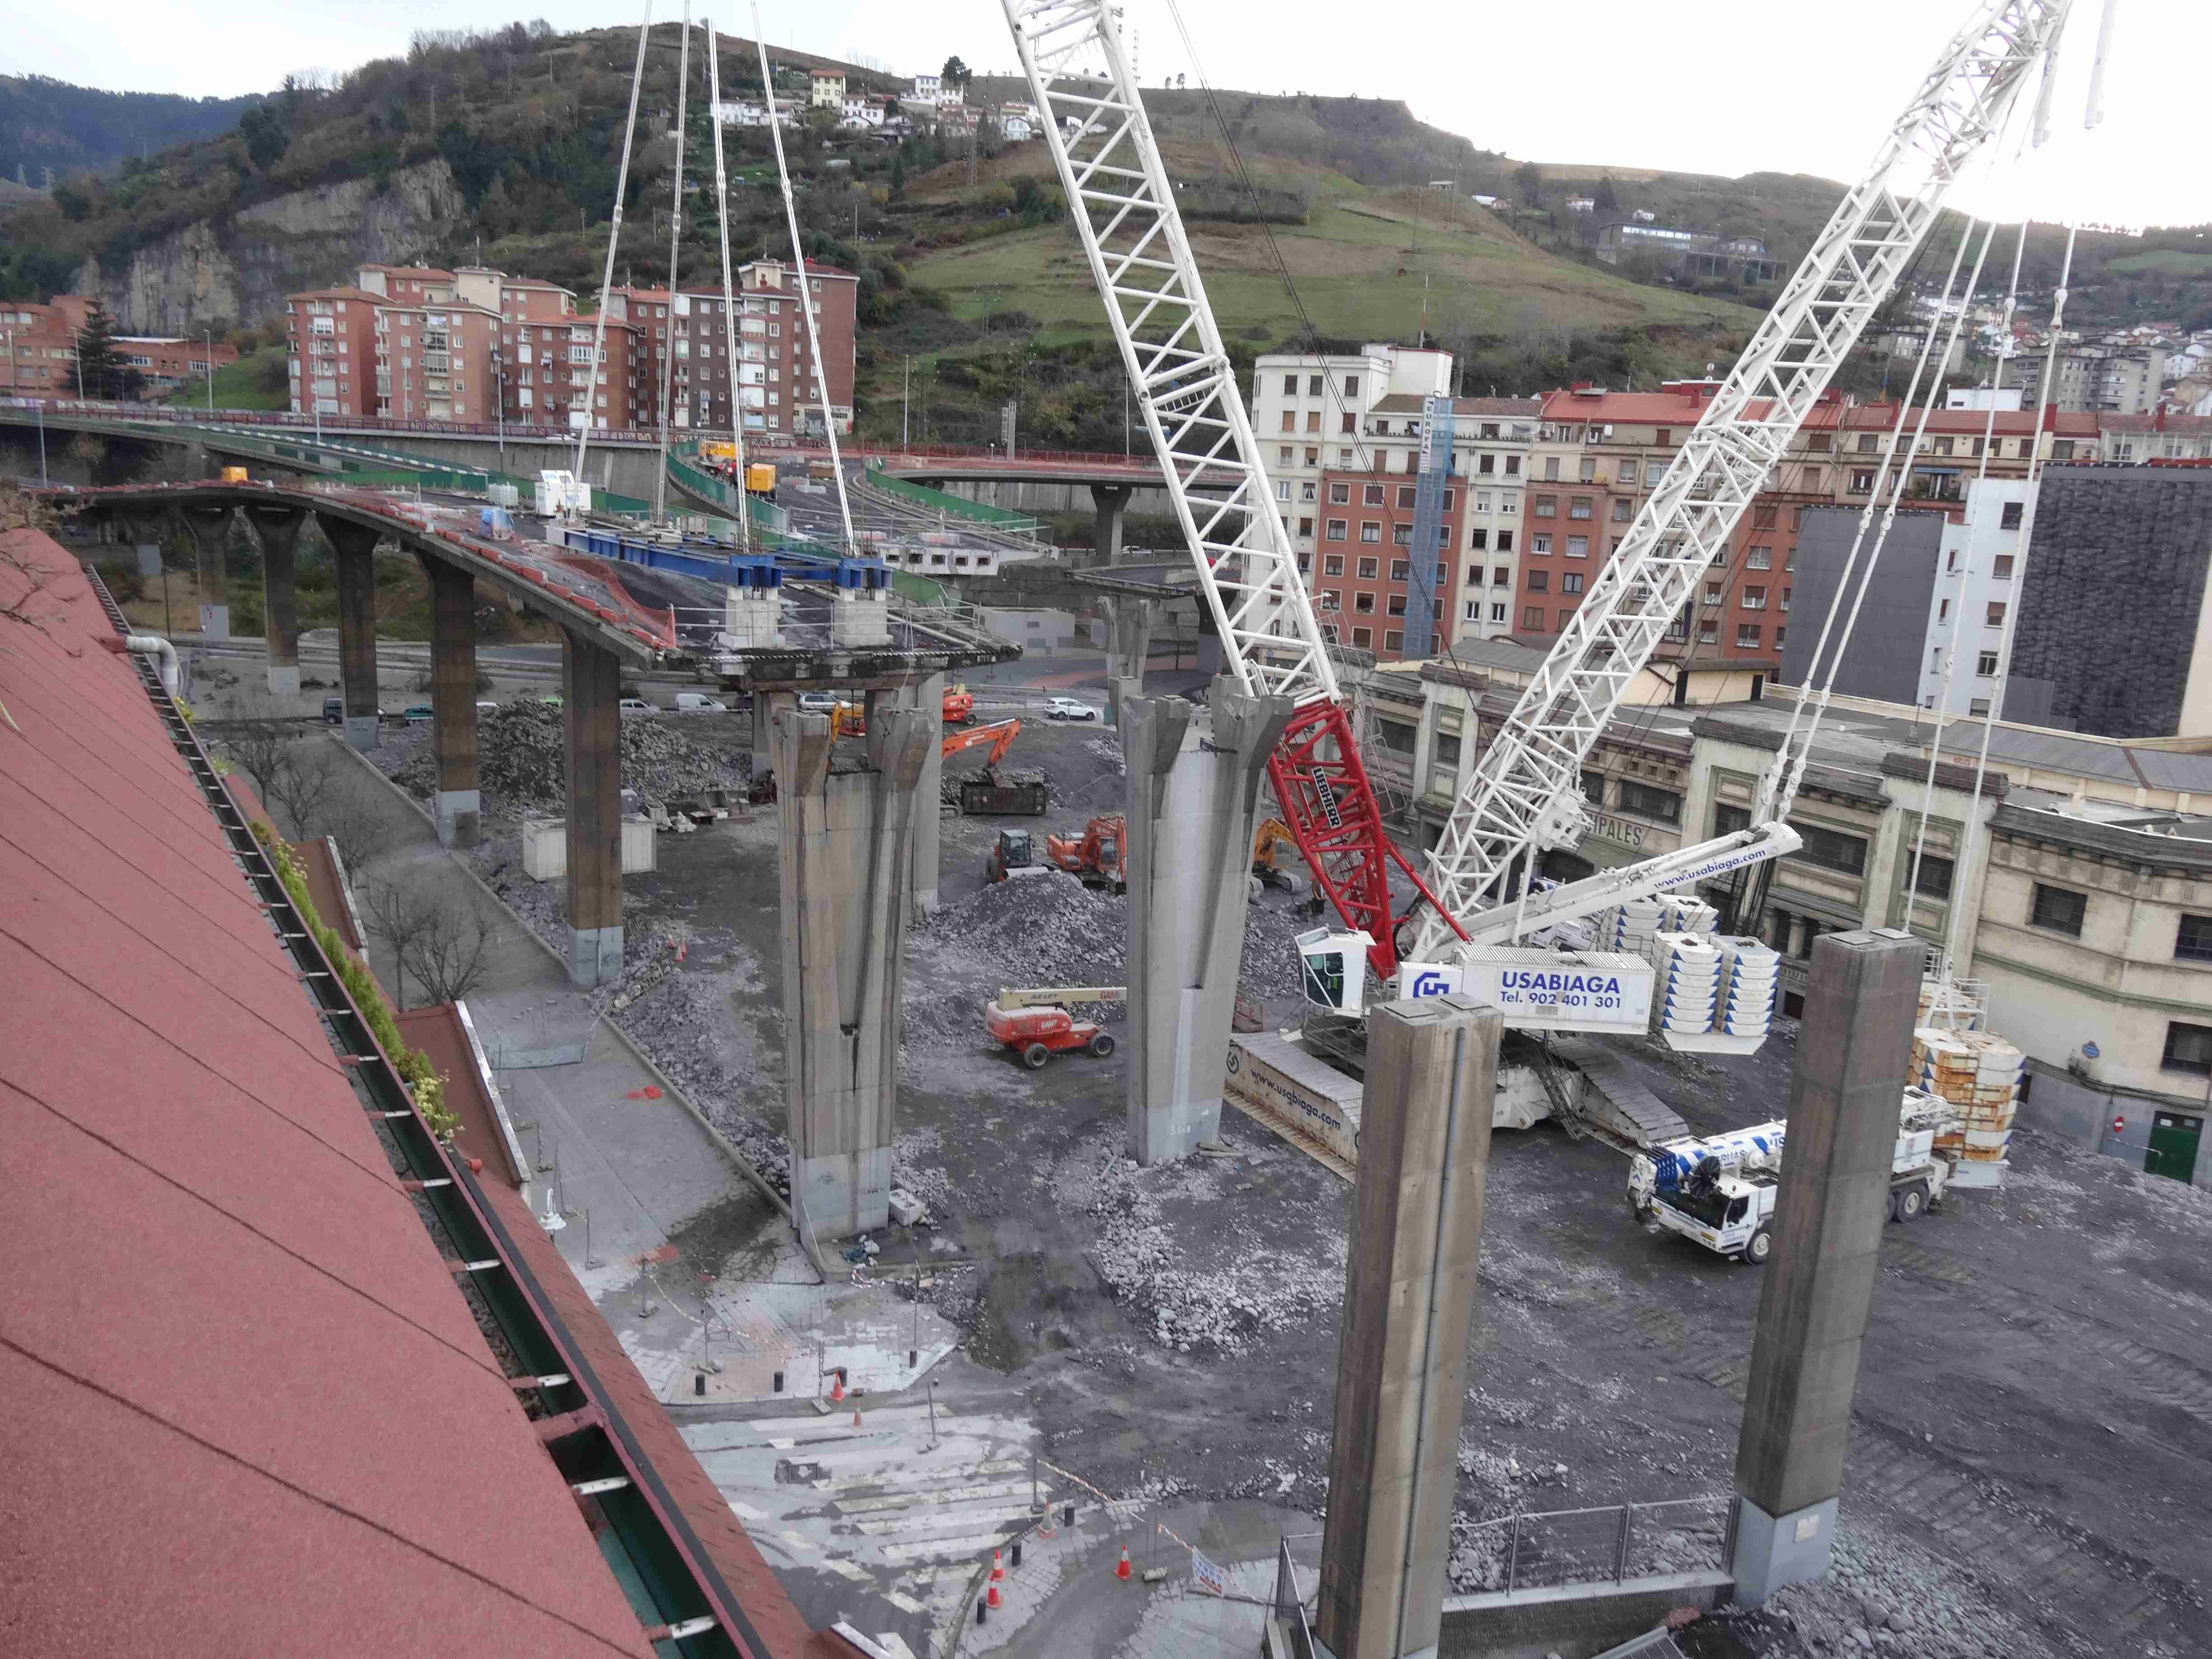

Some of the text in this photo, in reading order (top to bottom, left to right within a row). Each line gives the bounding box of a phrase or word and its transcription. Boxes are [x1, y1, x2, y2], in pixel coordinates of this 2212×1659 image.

[1424, 406, 1432, 449] EUROPA
[1313, 769, 1340, 827] LIEBHERR
[1654, 848, 1766, 889] www.usabiaga.com
[1500, 991, 1621, 1008] Tel. 902 401 301
[1502, 971, 1620, 994] USABIAGA
[1251, 1069, 1340, 1130] www.usabiaga.com
